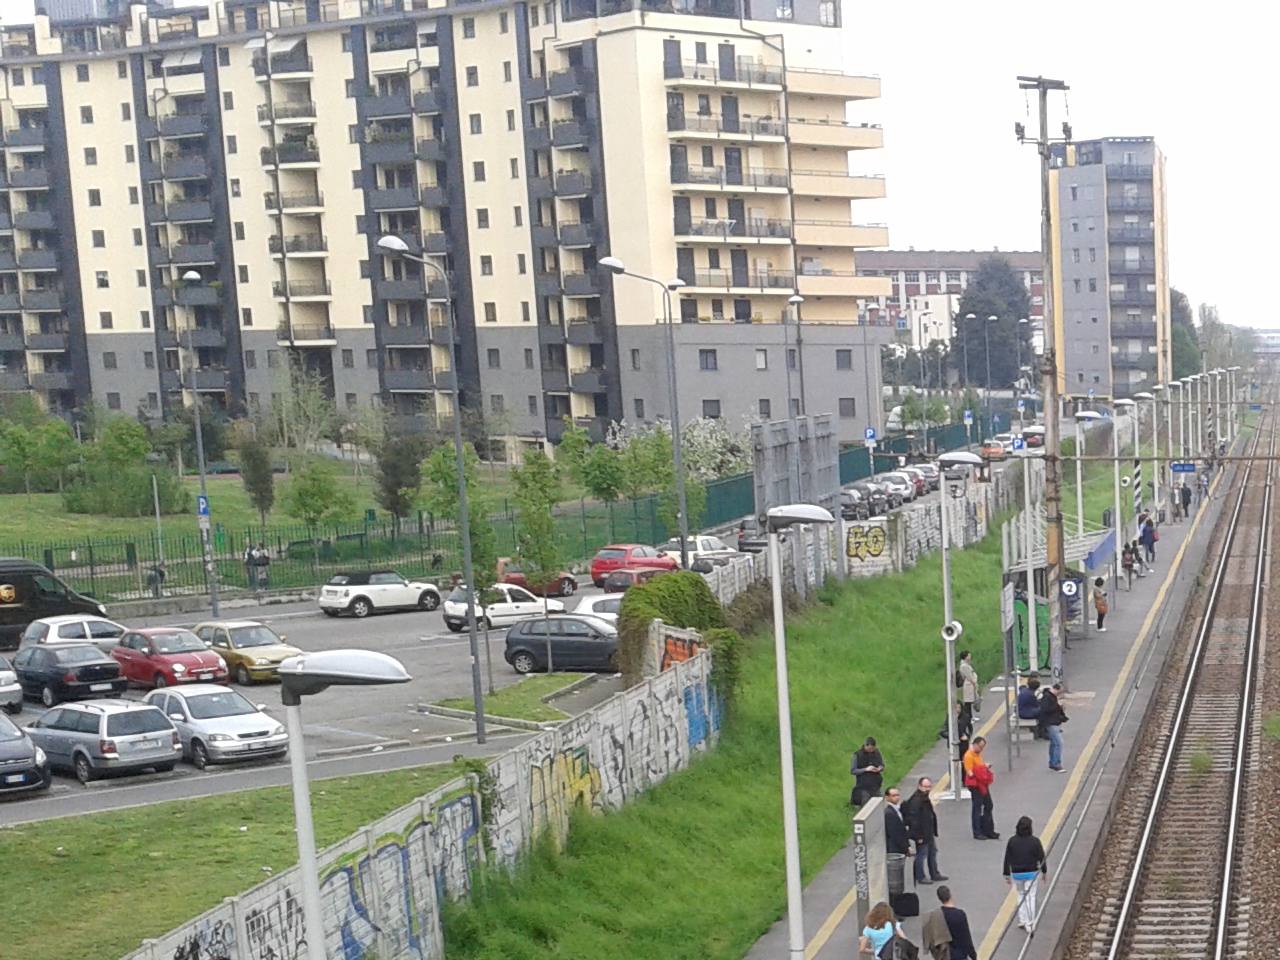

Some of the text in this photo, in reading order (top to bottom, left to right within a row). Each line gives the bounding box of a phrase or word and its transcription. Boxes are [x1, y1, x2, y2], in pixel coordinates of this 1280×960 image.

[866, 429, 874, 438] P
[1014, 439, 1022, 449] P
[200, 497, 206, 513] P
